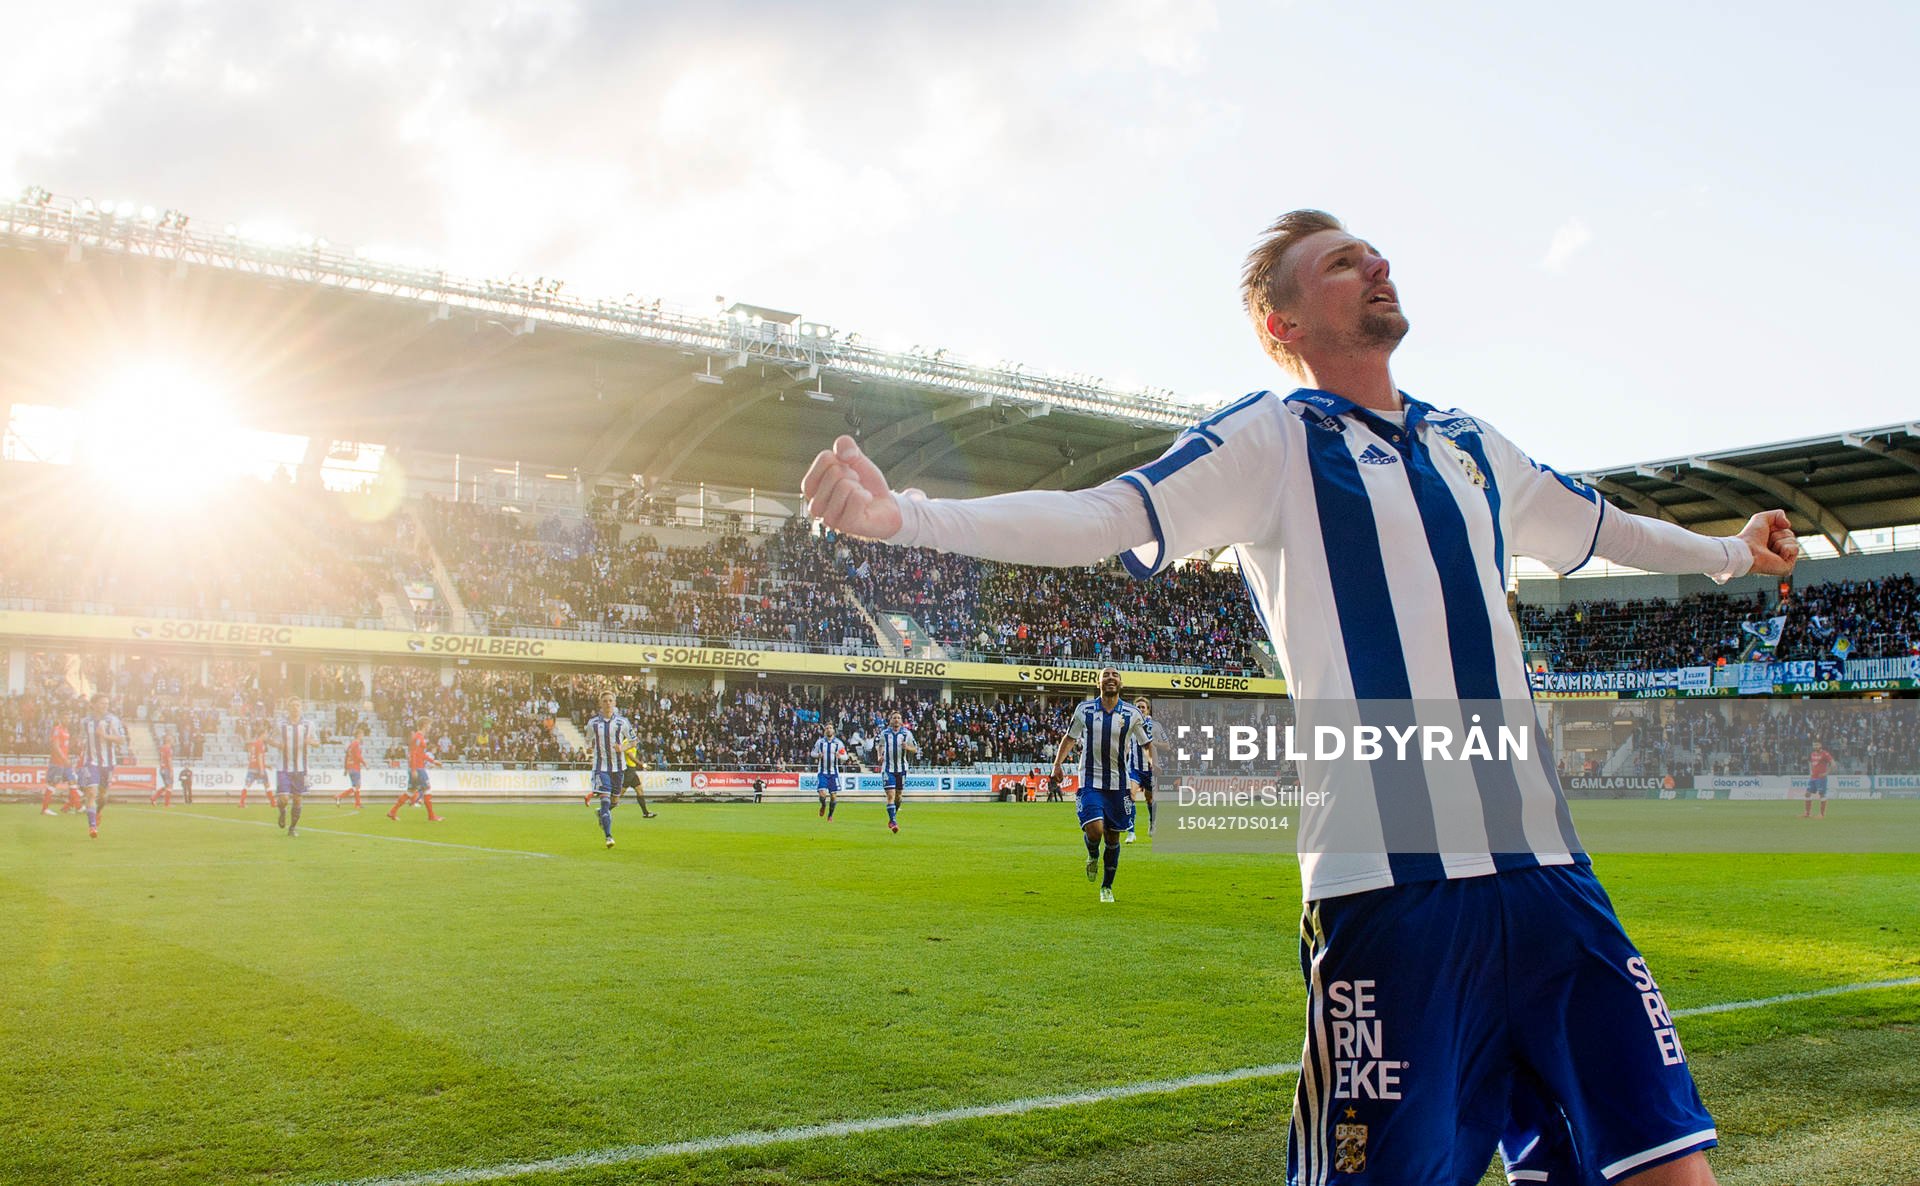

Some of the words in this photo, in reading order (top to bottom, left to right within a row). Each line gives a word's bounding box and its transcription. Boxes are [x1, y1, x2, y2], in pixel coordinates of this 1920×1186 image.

[159, 621, 293, 644] SOHLBERG
[431, 635, 545, 657] SOHLBERG
[662, 648, 760, 666] SOHLBERG
[861, 659, 946, 676] SOHLBERG
[1034, 668, 1099, 683] SOHLBER
[1184, 676, 1249, 691] SOHLBERG
[1543, 671, 1656, 691] KAMRATERNA
[385, 772, 407, 787] hig
[456, 771, 551, 788] Wallenstam
[1571, 777, 1614, 789] GAMLA
[1626, 777, 1664, 789] ULLEV
[1713, 778, 1736, 788] clean
[1738, 779, 1760, 789] park
[1838, 779, 1860, 787] WHC
[1328, 980, 1376, 1018] SE
[1332, 1020, 1382, 1058] RN
